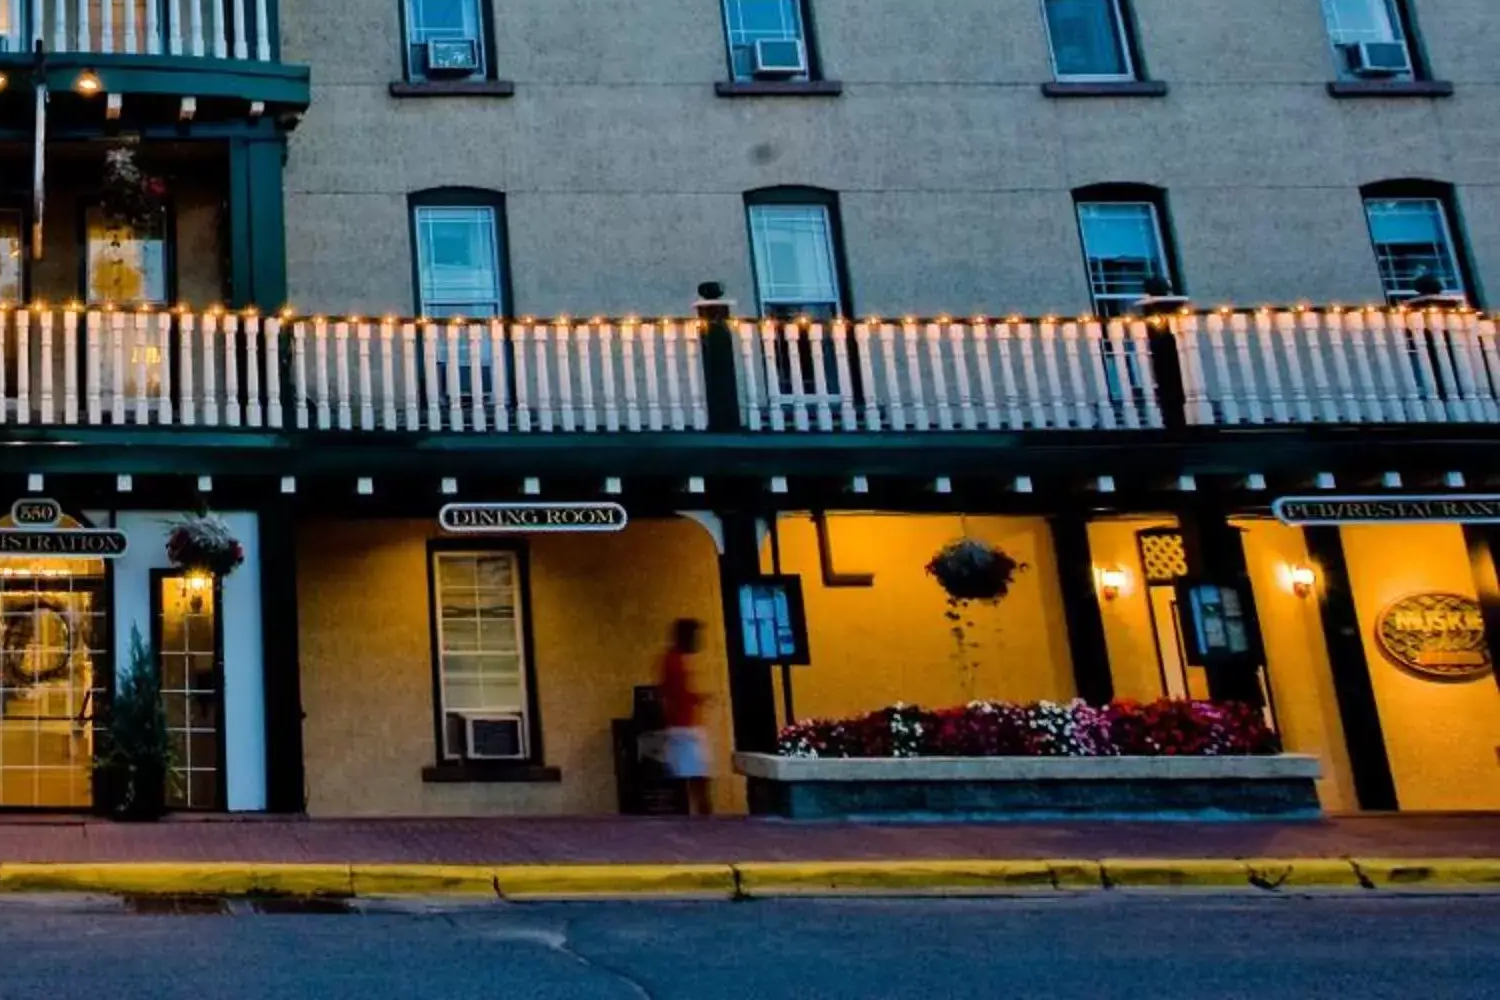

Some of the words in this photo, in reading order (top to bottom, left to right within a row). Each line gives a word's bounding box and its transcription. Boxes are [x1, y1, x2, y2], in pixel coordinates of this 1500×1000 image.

[452, 508, 538, 526] DINING
[546, 508, 615, 525] ROOM
[1286, 501, 1500, 518] PUB/RESTAURAN
